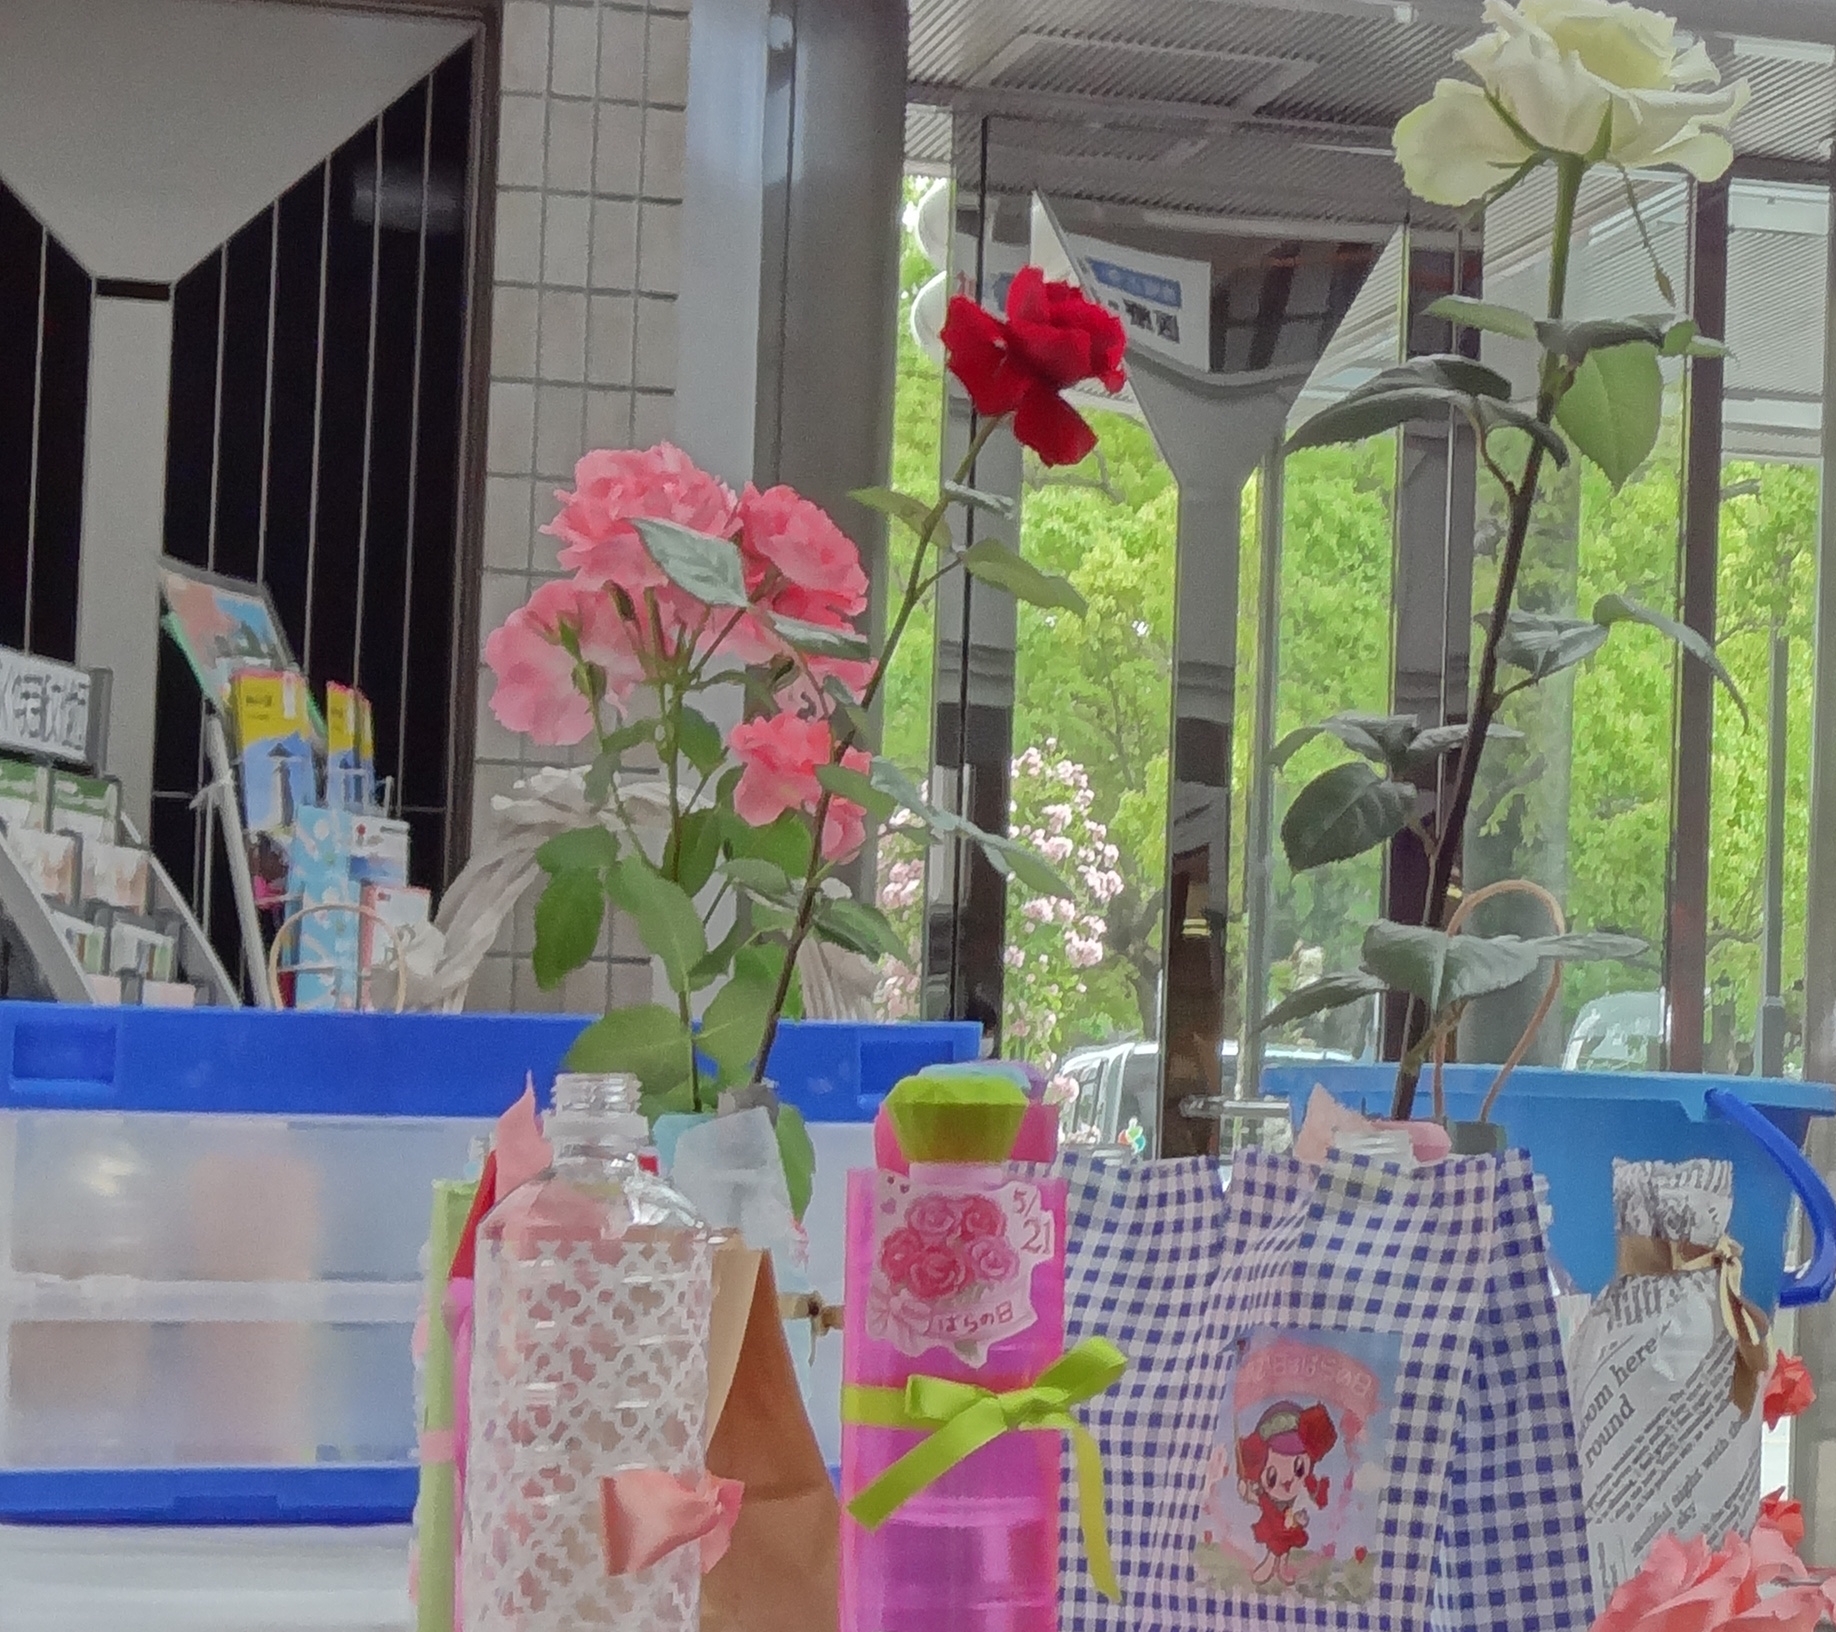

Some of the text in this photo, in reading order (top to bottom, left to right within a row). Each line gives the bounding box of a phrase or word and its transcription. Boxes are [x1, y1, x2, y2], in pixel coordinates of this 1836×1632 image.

[1021, 1218, 1051, 1255] 21
[938, 1300, 1014, 1333] ばらの日
[1609, 1337, 1657, 1387] here
[1585, 1392, 1636, 1469] round
